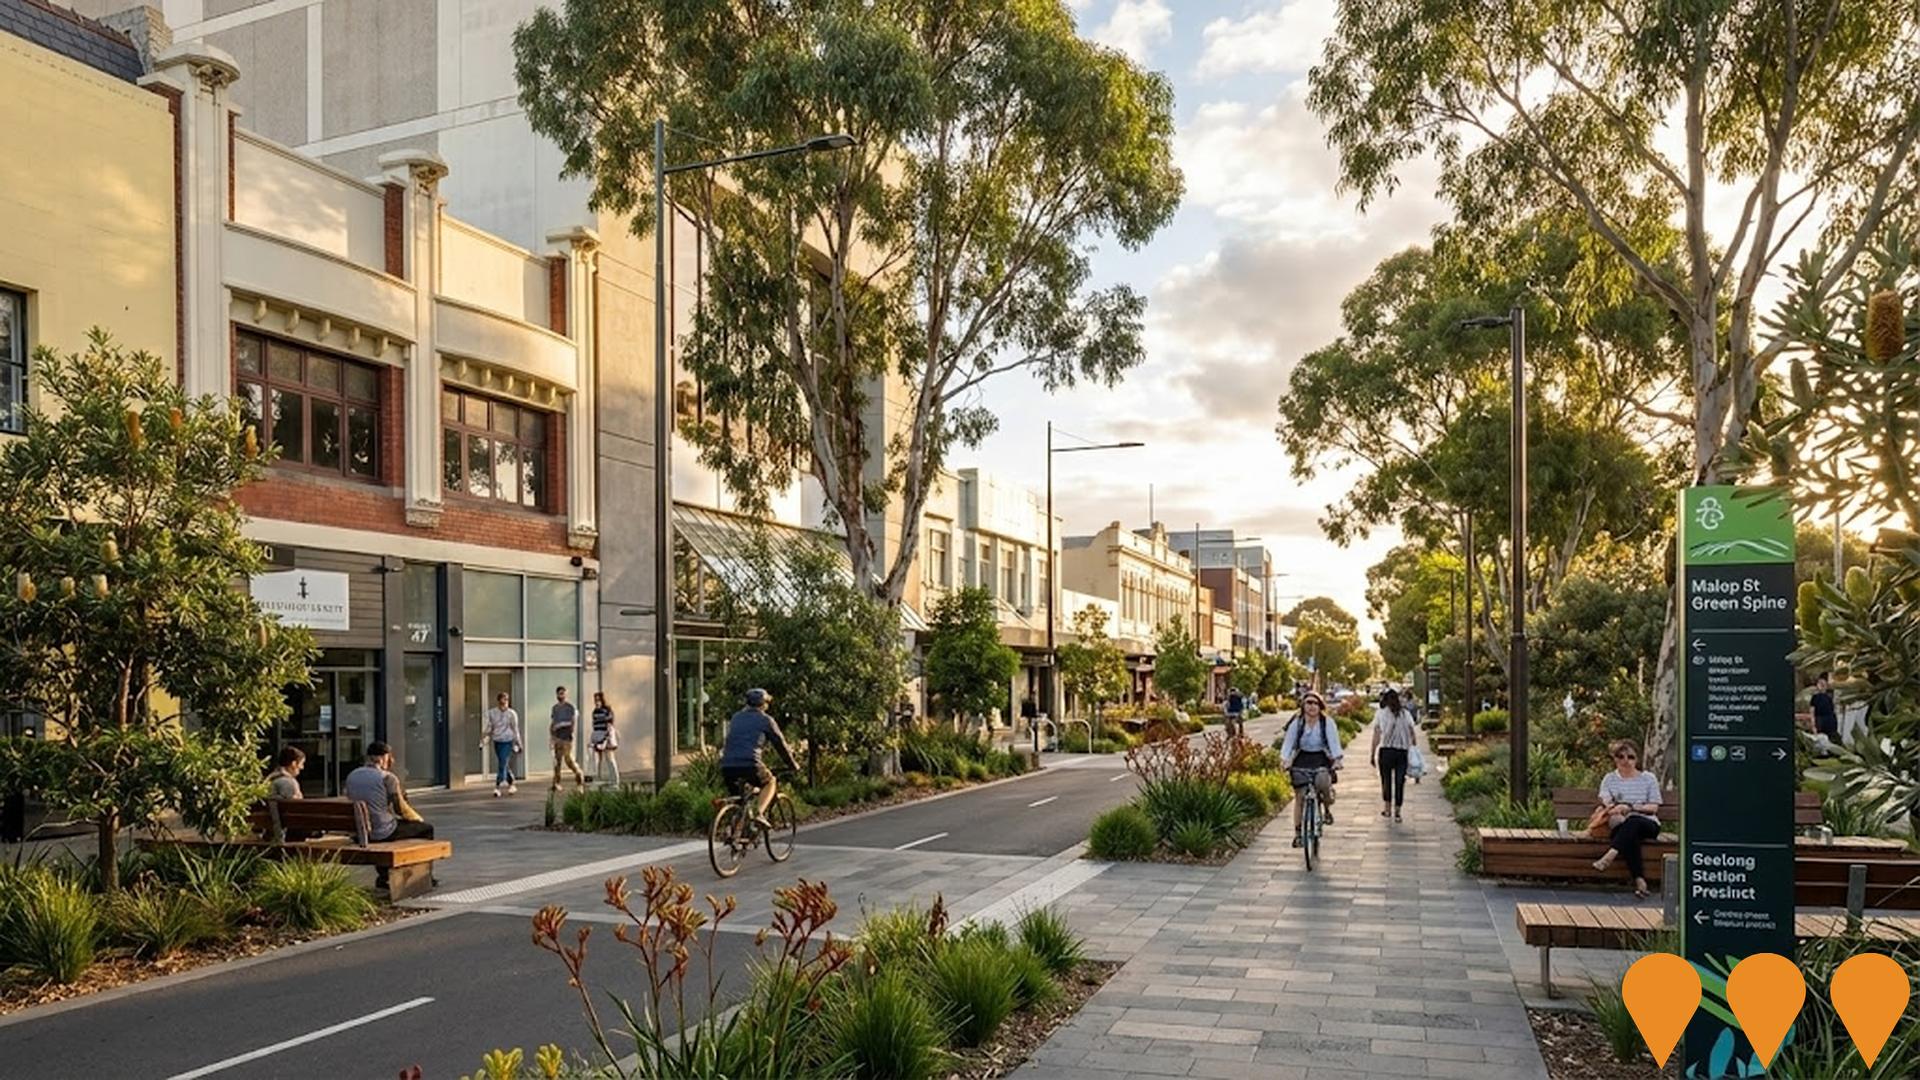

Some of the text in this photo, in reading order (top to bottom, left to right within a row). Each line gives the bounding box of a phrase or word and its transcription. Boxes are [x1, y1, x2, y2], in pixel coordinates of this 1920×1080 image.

[1692, 578, 1760, 595] Malop St
[1692, 595, 1787, 612] Green Spine
[1692, 852, 1756, 871] Geelong
